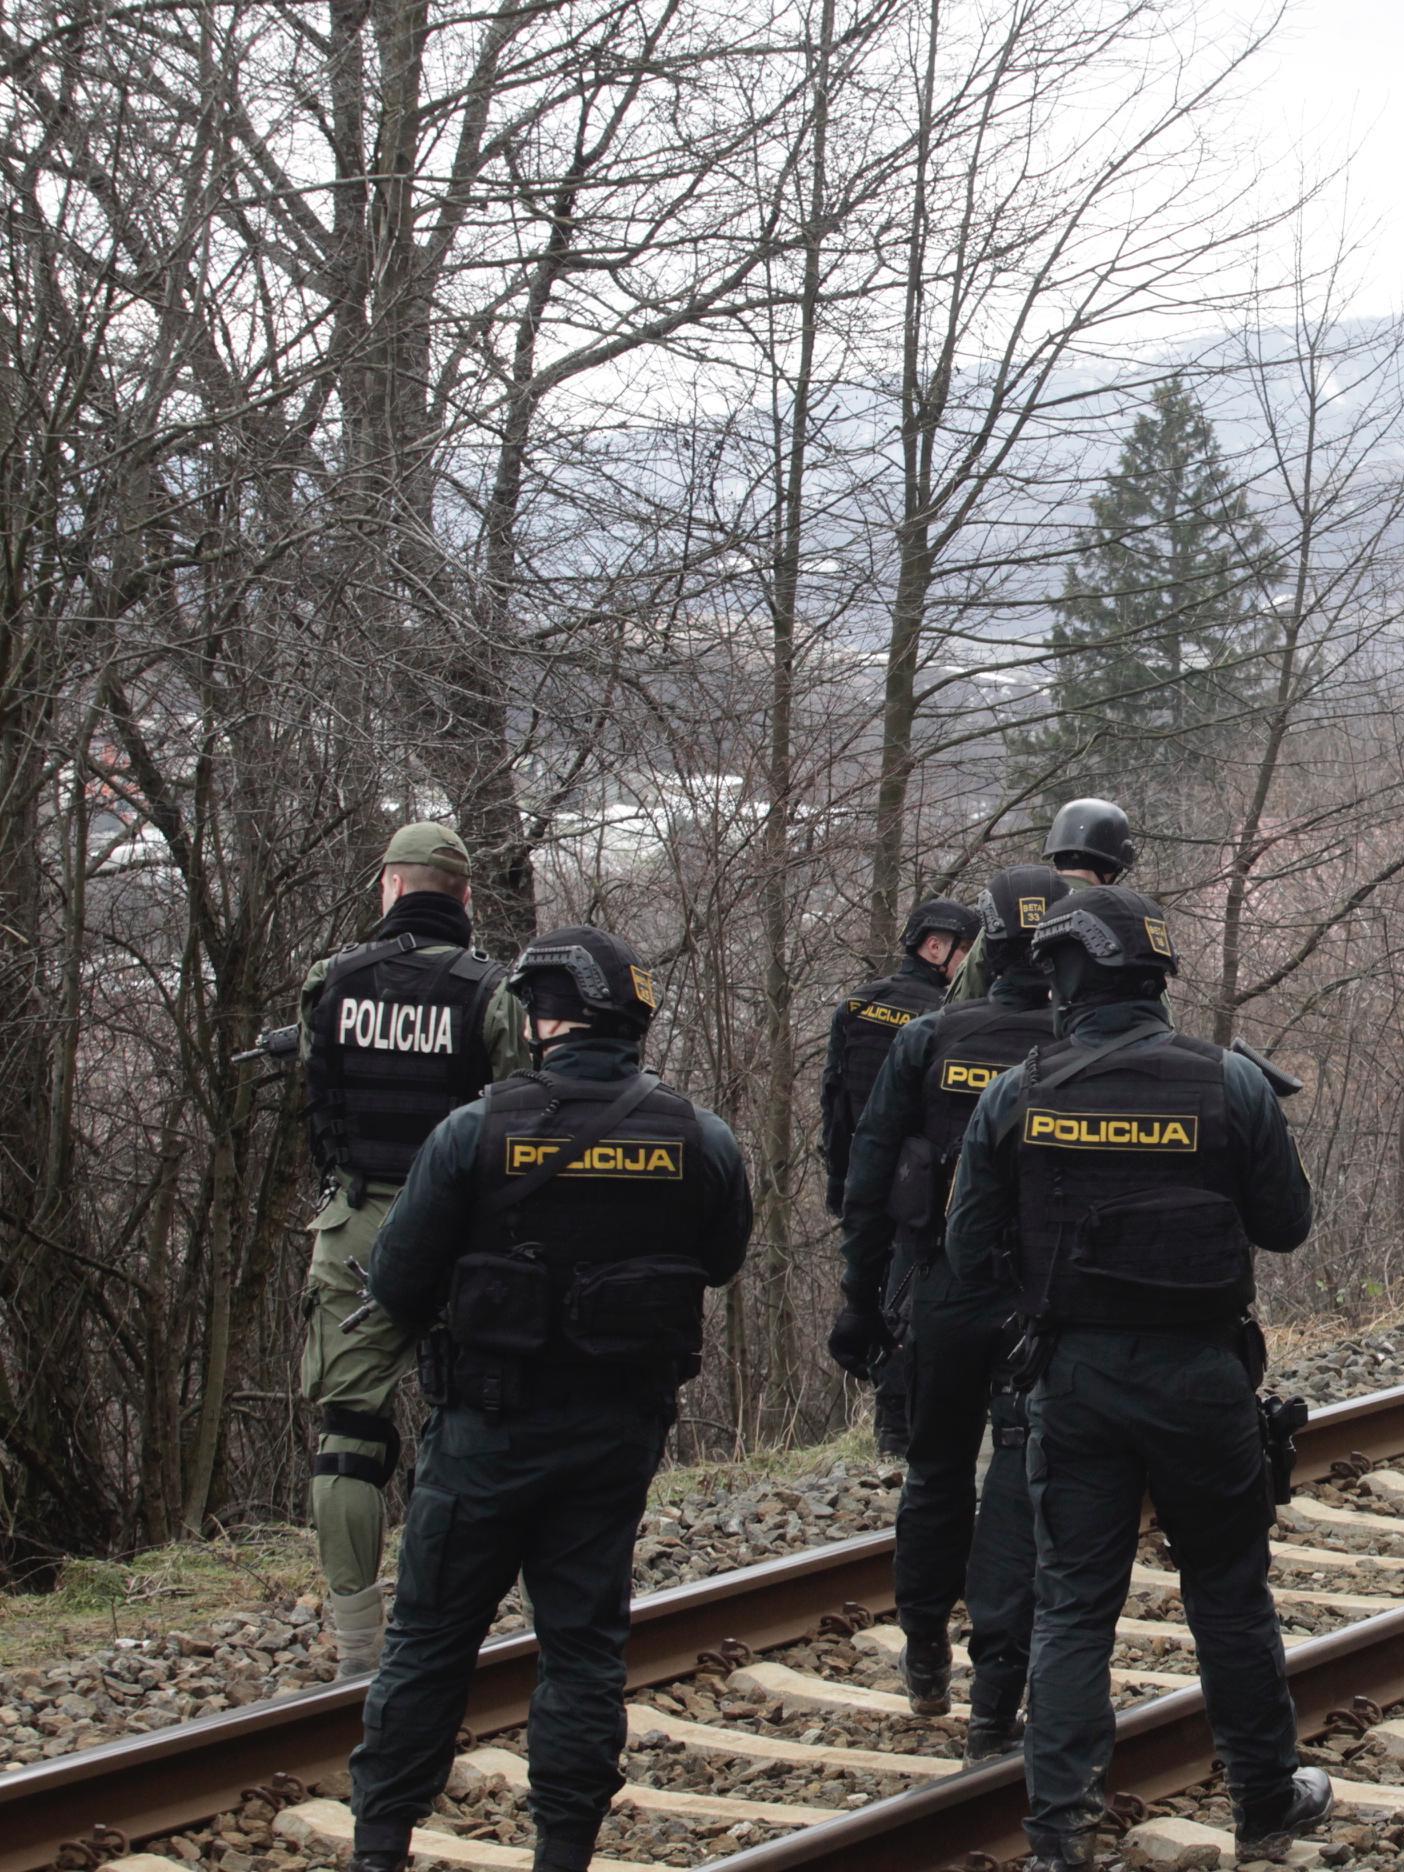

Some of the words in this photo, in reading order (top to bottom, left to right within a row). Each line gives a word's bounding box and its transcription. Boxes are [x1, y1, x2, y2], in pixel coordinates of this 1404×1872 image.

[1023, 904, 1043, 912] BETA
[1027, 912, 1040, 921] 33
[339, 998, 453, 1054] POLICIJA
[1031, 1115, 1190, 1144] POLICIJA
